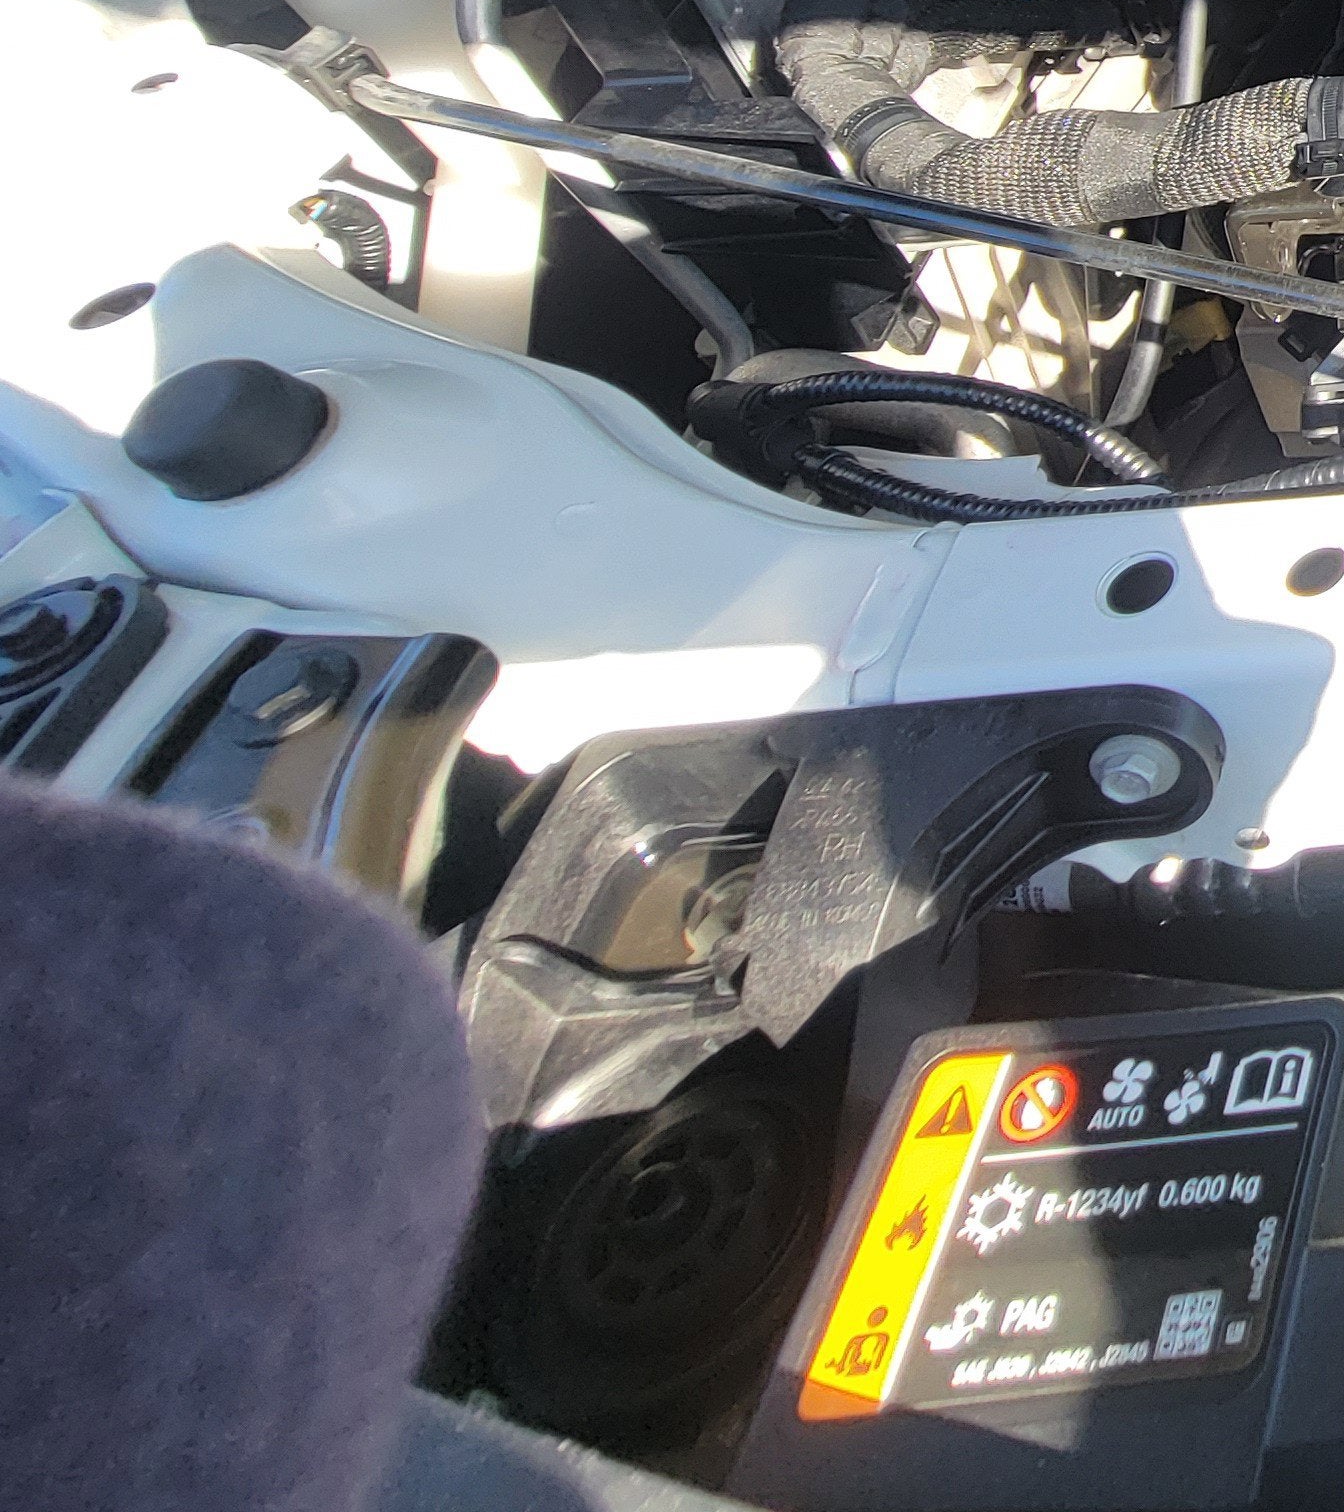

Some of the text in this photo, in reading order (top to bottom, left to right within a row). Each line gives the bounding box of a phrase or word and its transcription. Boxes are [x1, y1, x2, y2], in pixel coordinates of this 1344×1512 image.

[1087, 1104, 1145, 1131] AUTO
[1035, 1171, 1262, 1224] R-1234yf 0.600 kg
[999, 1294, 1058, 1335] PAG
